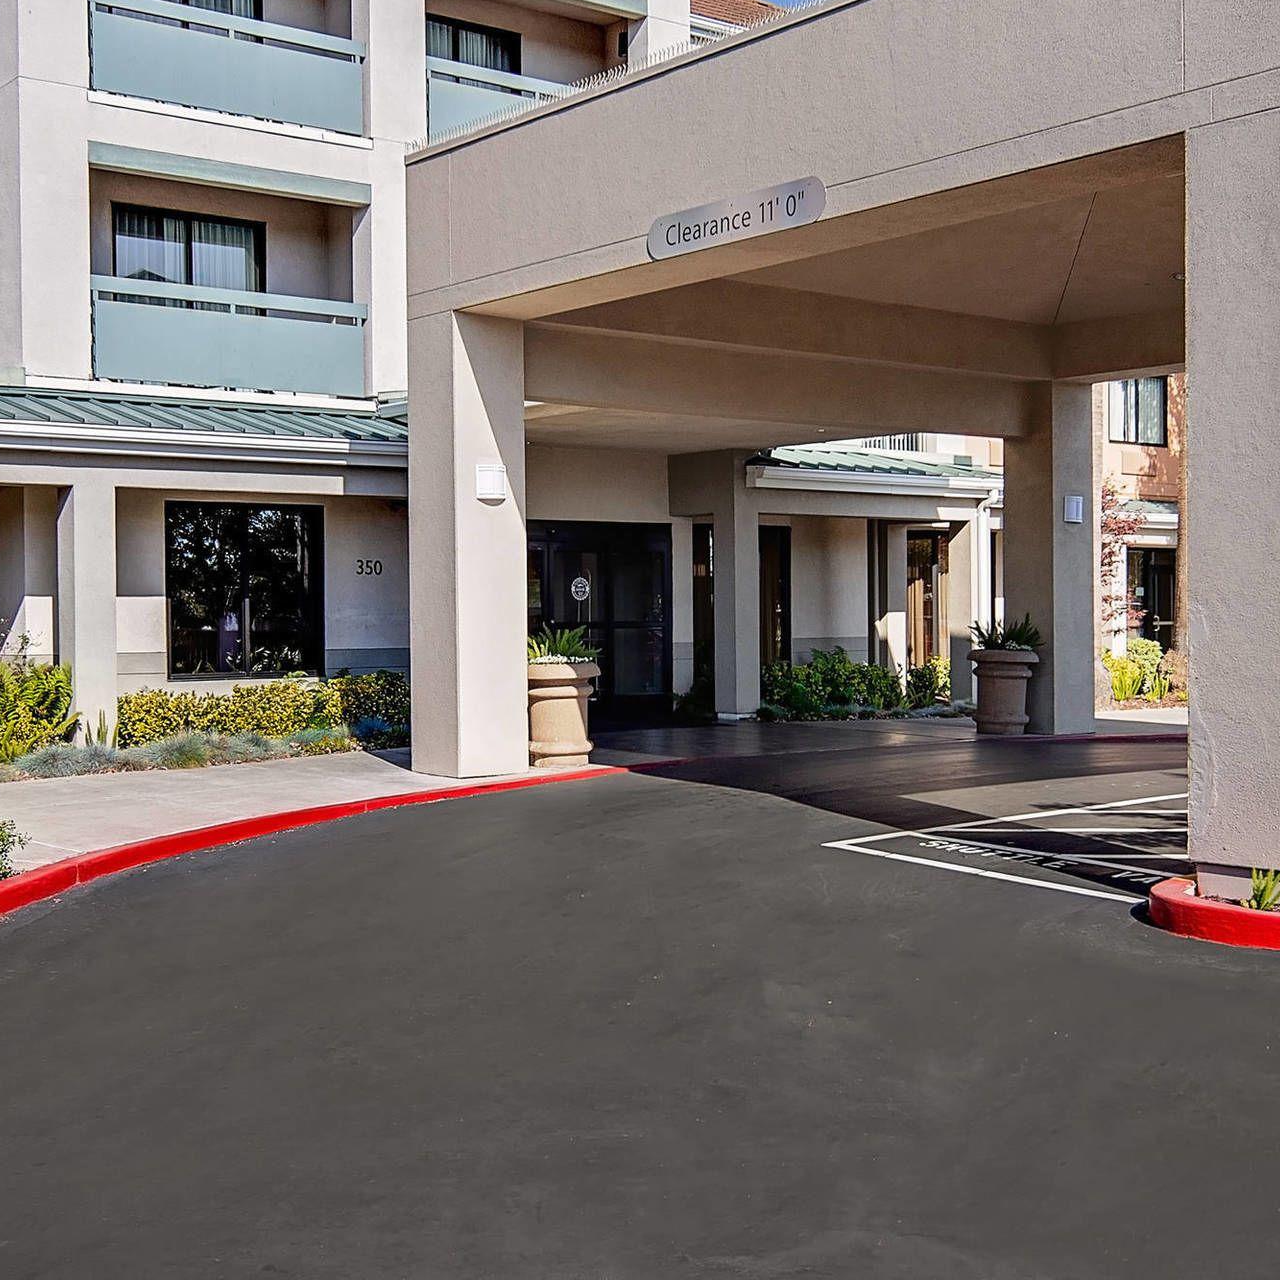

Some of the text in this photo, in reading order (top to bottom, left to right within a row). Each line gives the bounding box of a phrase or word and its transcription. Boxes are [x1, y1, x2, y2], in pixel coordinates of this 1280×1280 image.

[665, 190, 805, 246] Clearance 11' 0"
[356, 559, 383, 576] 350
[919, 840, 1164, 884] SHUTTLE VA
